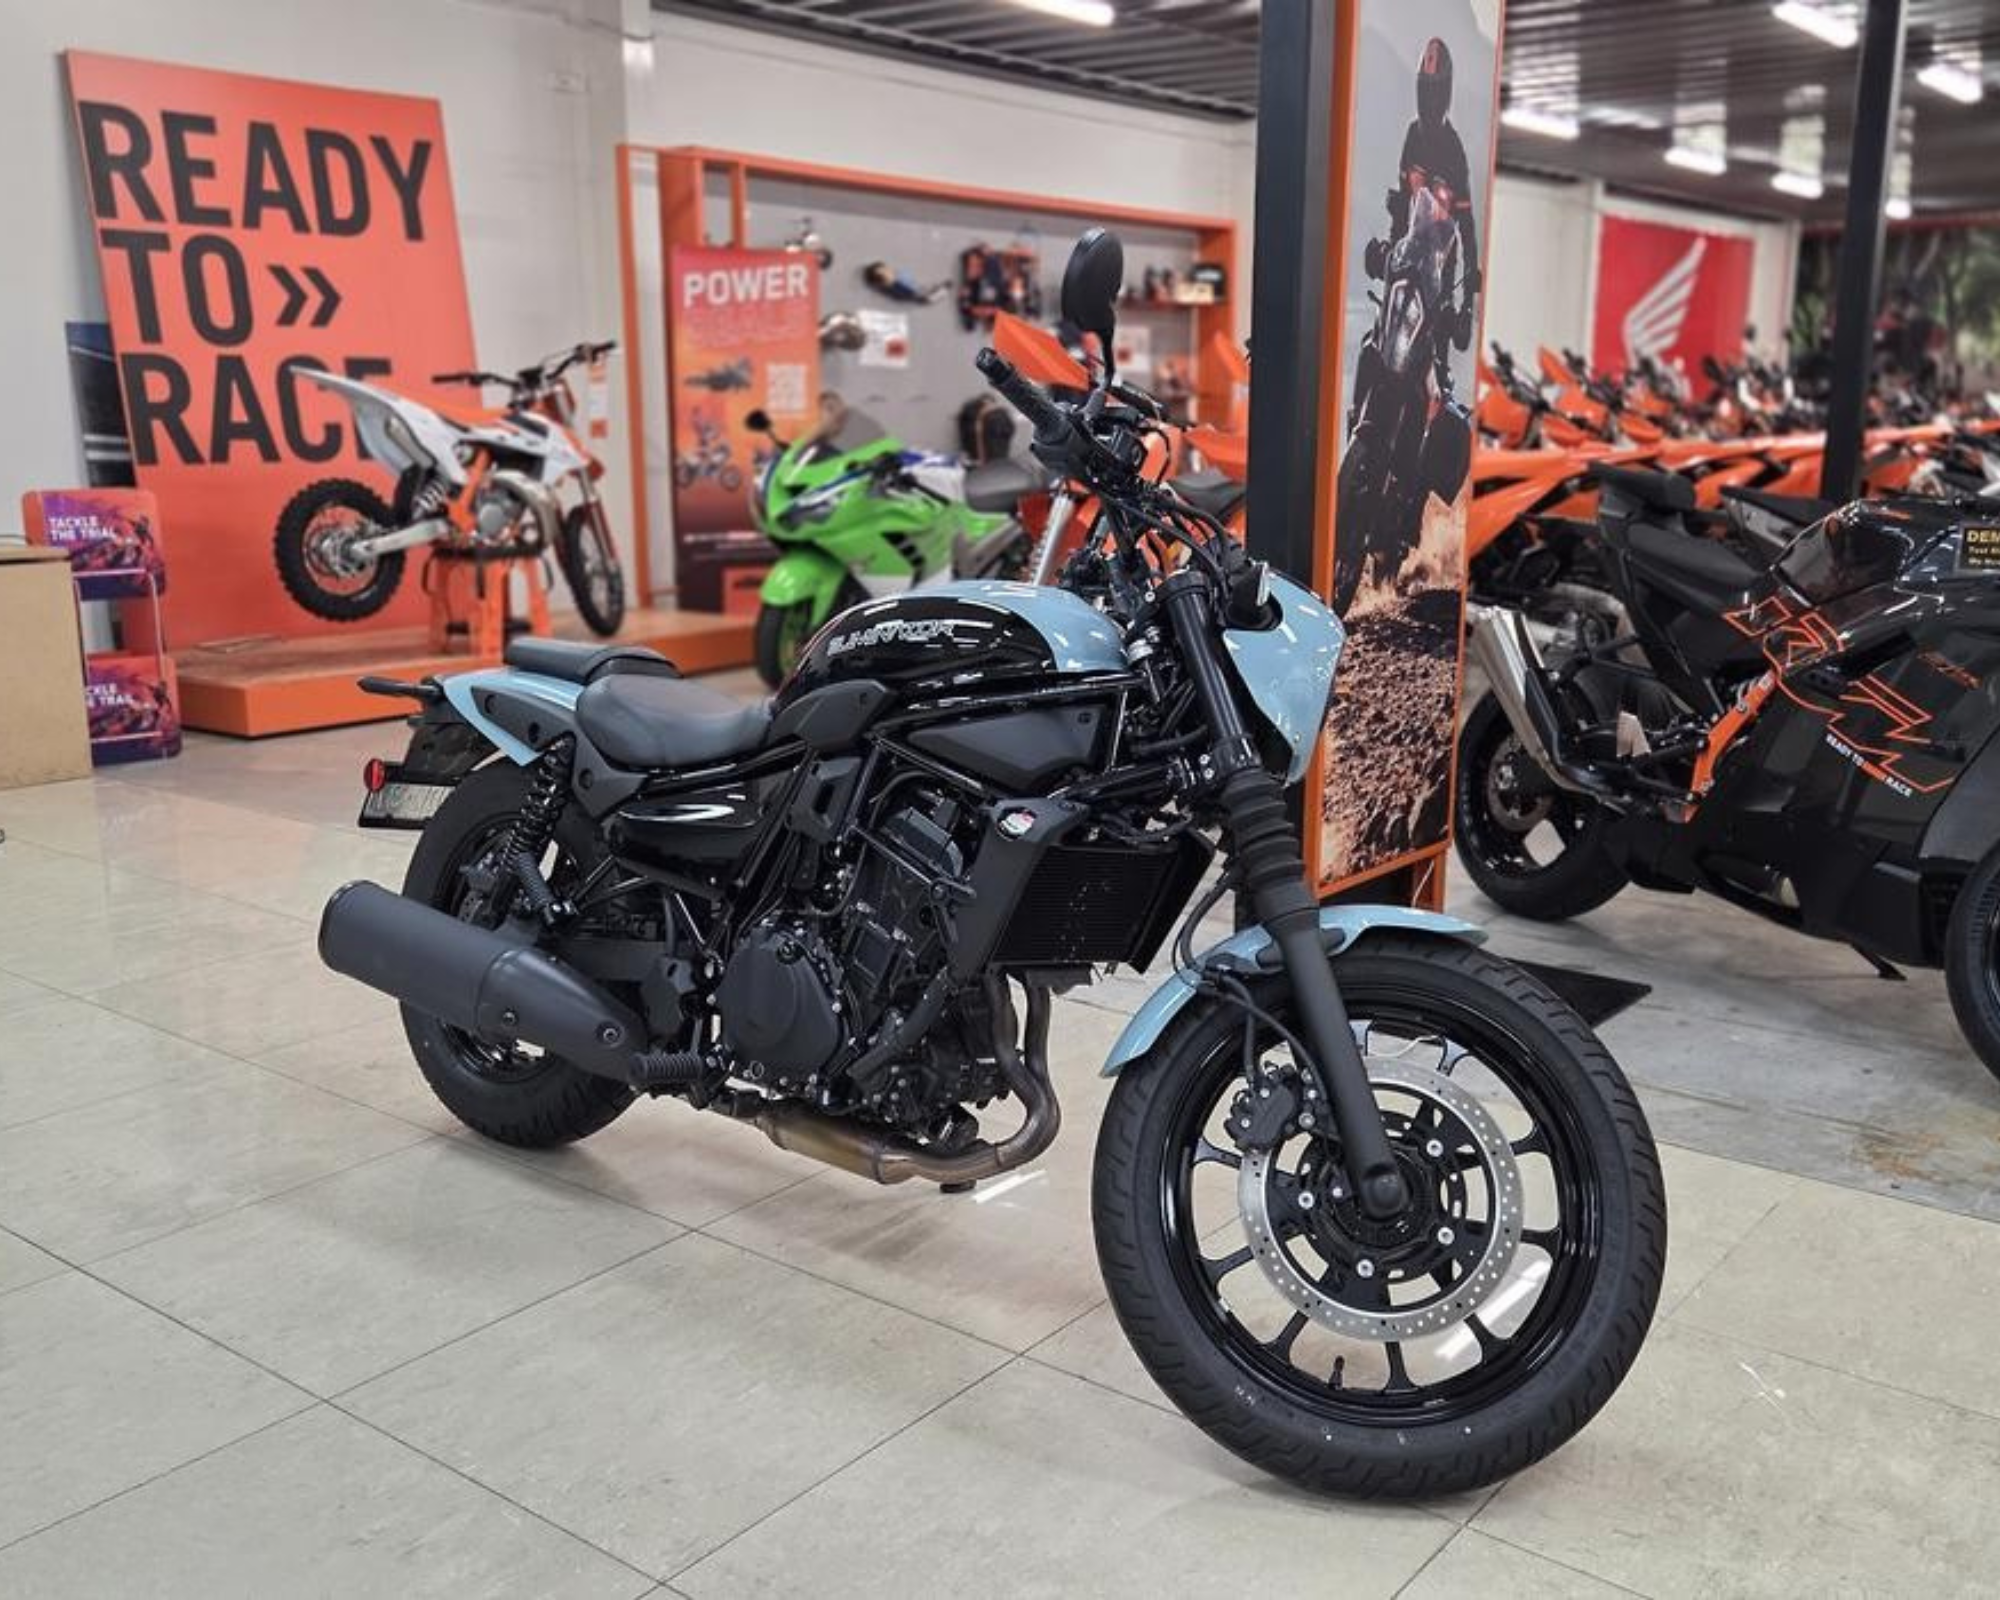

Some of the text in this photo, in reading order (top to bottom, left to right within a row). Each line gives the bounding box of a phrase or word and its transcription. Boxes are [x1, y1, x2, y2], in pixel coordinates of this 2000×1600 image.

[79, 100, 432, 241] READY
[101, 227, 254, 347] TO
[684, 264, 808, 309] POWER
[49, 515, 98, 530] TACKLE
[1885, 777, 1912, 796] RACE
